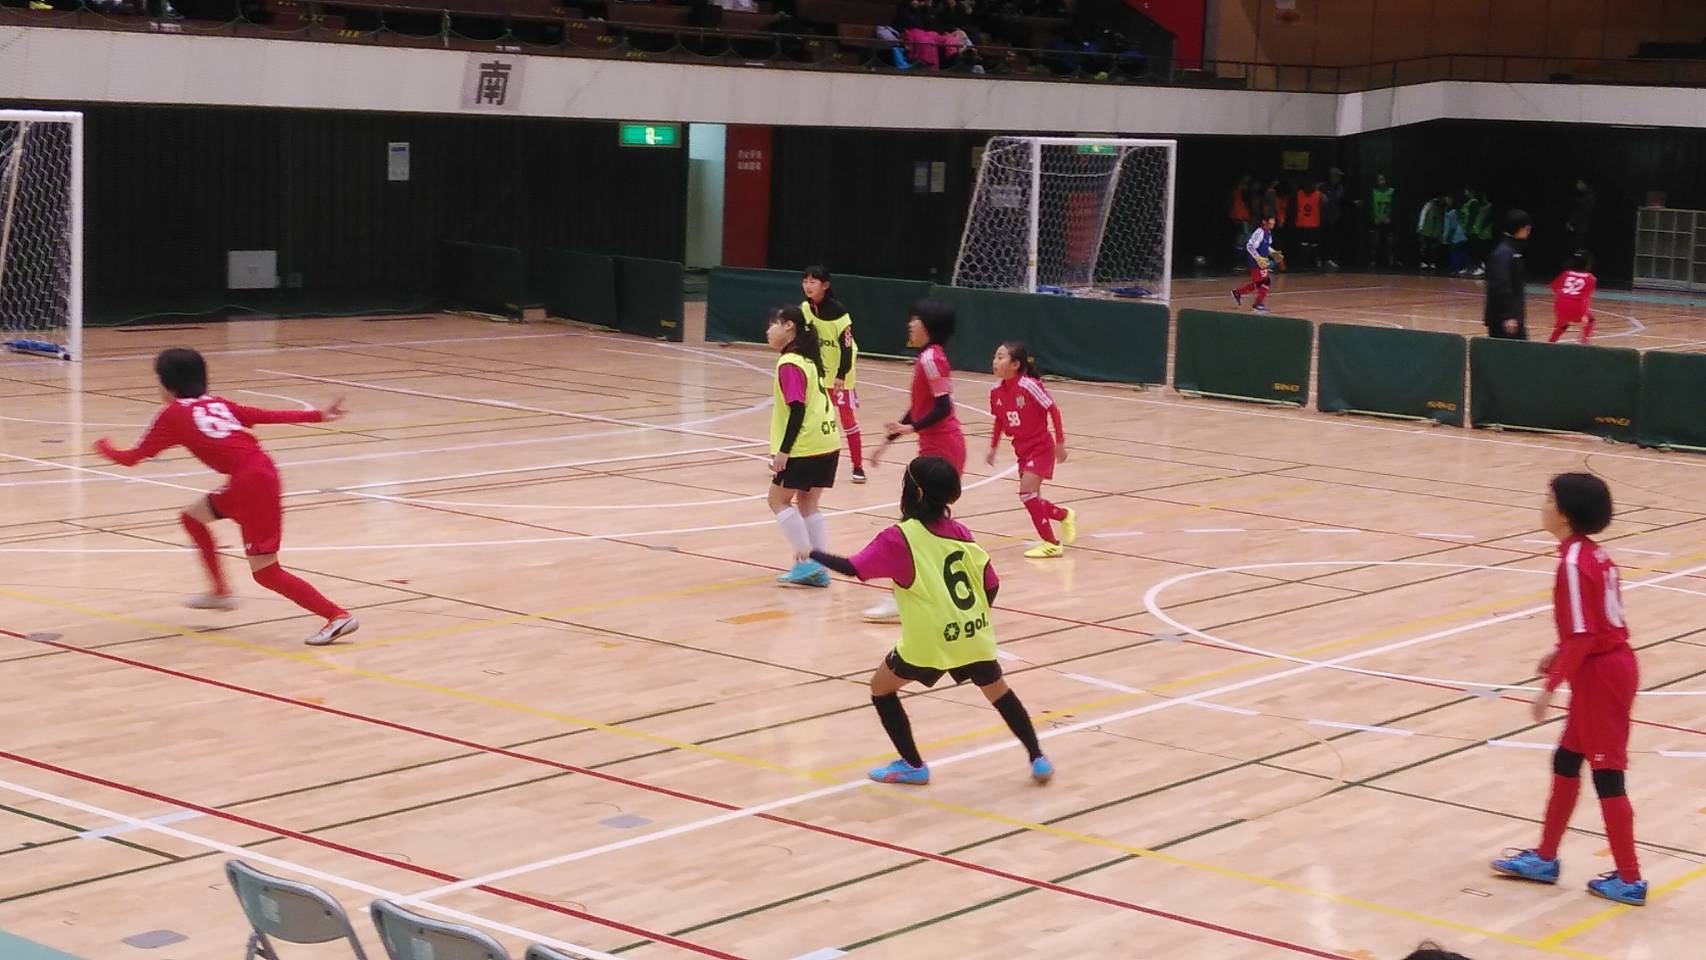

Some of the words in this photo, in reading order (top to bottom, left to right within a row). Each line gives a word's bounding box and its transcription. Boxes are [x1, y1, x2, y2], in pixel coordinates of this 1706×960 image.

[476, 60, 512, 105] 南
[1562, 276, 1586, 295] 52
[943, 550, 977, 611] 6
